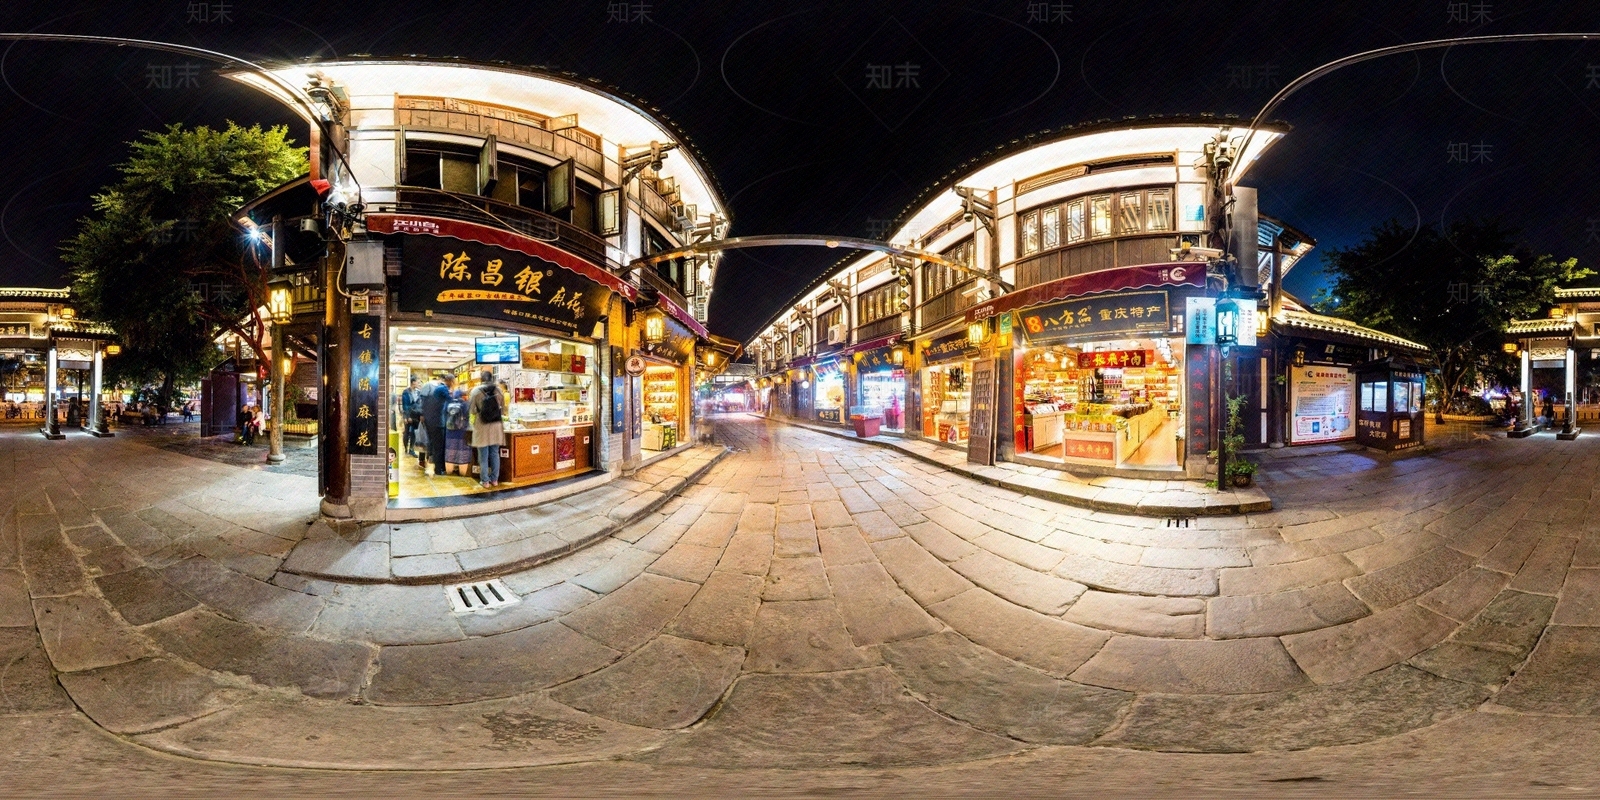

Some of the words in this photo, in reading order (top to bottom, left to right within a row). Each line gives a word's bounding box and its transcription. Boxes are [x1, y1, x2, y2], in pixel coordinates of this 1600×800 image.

[440, 251, 544, 296] 陈昌银
[1098, 306, 1161, 322] 重庆特产
